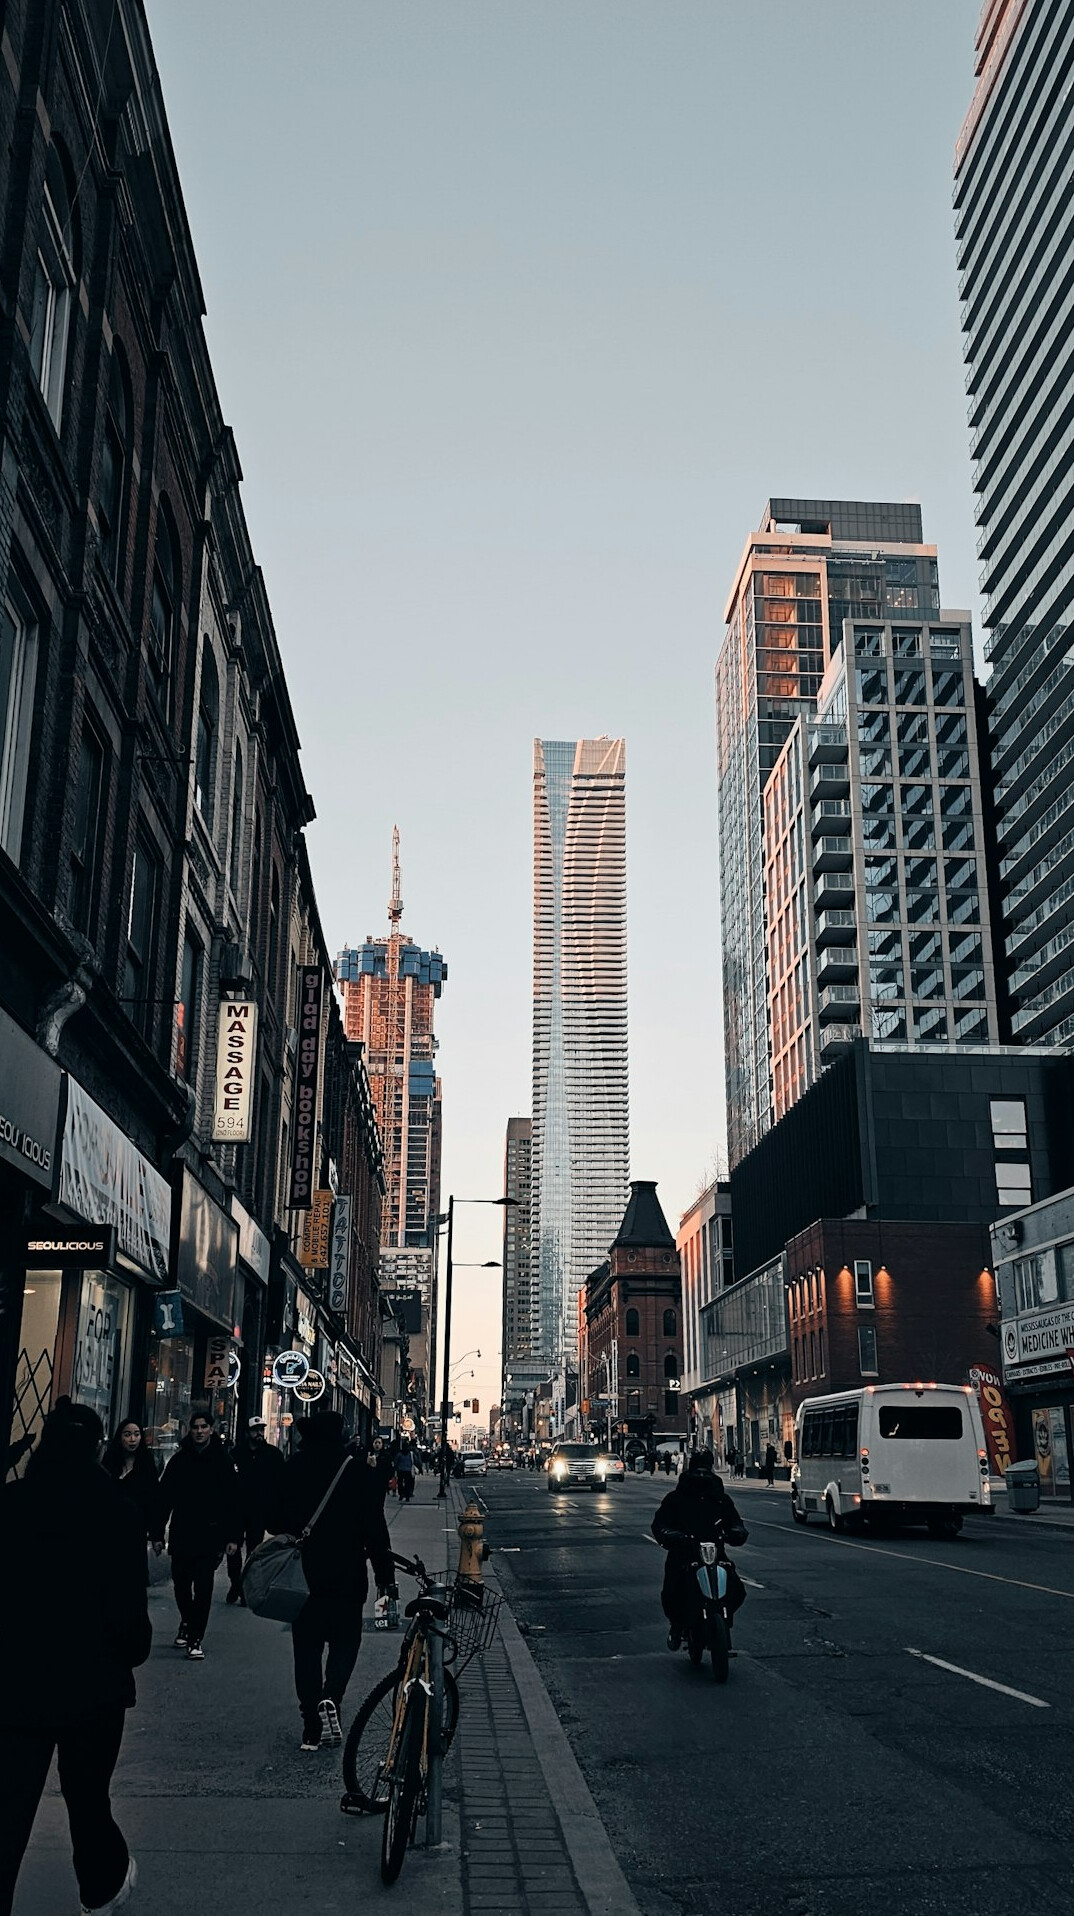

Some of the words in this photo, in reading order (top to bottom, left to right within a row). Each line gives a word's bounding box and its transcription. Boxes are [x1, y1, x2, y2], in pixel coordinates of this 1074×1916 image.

[302, 974, 319, 1030] glad
[223, 1005, 249, 1110] MASSAGE
[300, 1037, 316, 1078] day
[217, 1117, 243, 1128] 594
[294, 1084, 314, 1198] bookshop
[27, 1240, 105, 1251] SEOULICIOUS
[332, 1198, 348, 1309] TATTOO
[87, 1304, 112, 1341] FOR
[1021, 1316, 1055, 1332] MISSISSAUGAS
[1054, 1314, 1061, 1325] OF
[1061, 1312, 1071, 1323] THE
[208, 1339, 226, 1378] SPA
[1022, 1329, 1060, 1354] MEDICINE
[207, 1379, 226, 1387] 2F
